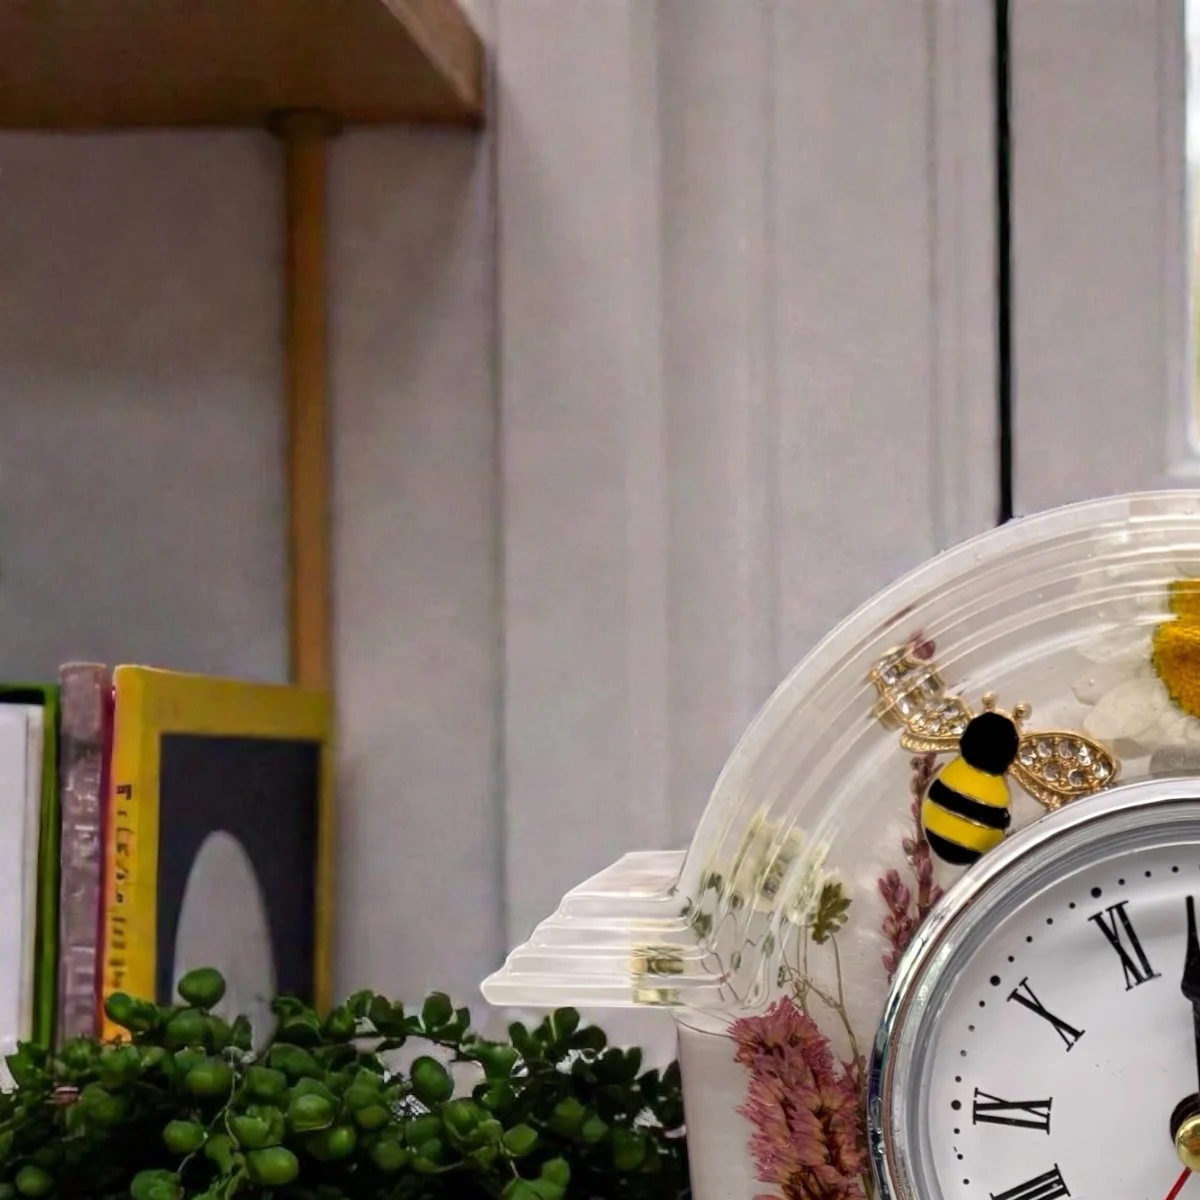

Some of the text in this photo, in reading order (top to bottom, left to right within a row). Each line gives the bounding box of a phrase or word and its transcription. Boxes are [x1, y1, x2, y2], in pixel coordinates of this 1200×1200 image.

[1088, 900, 1162, 991] XI
[1006, 976, 1086, 1052] X
[972, 1087, 1053, 1135] IX
